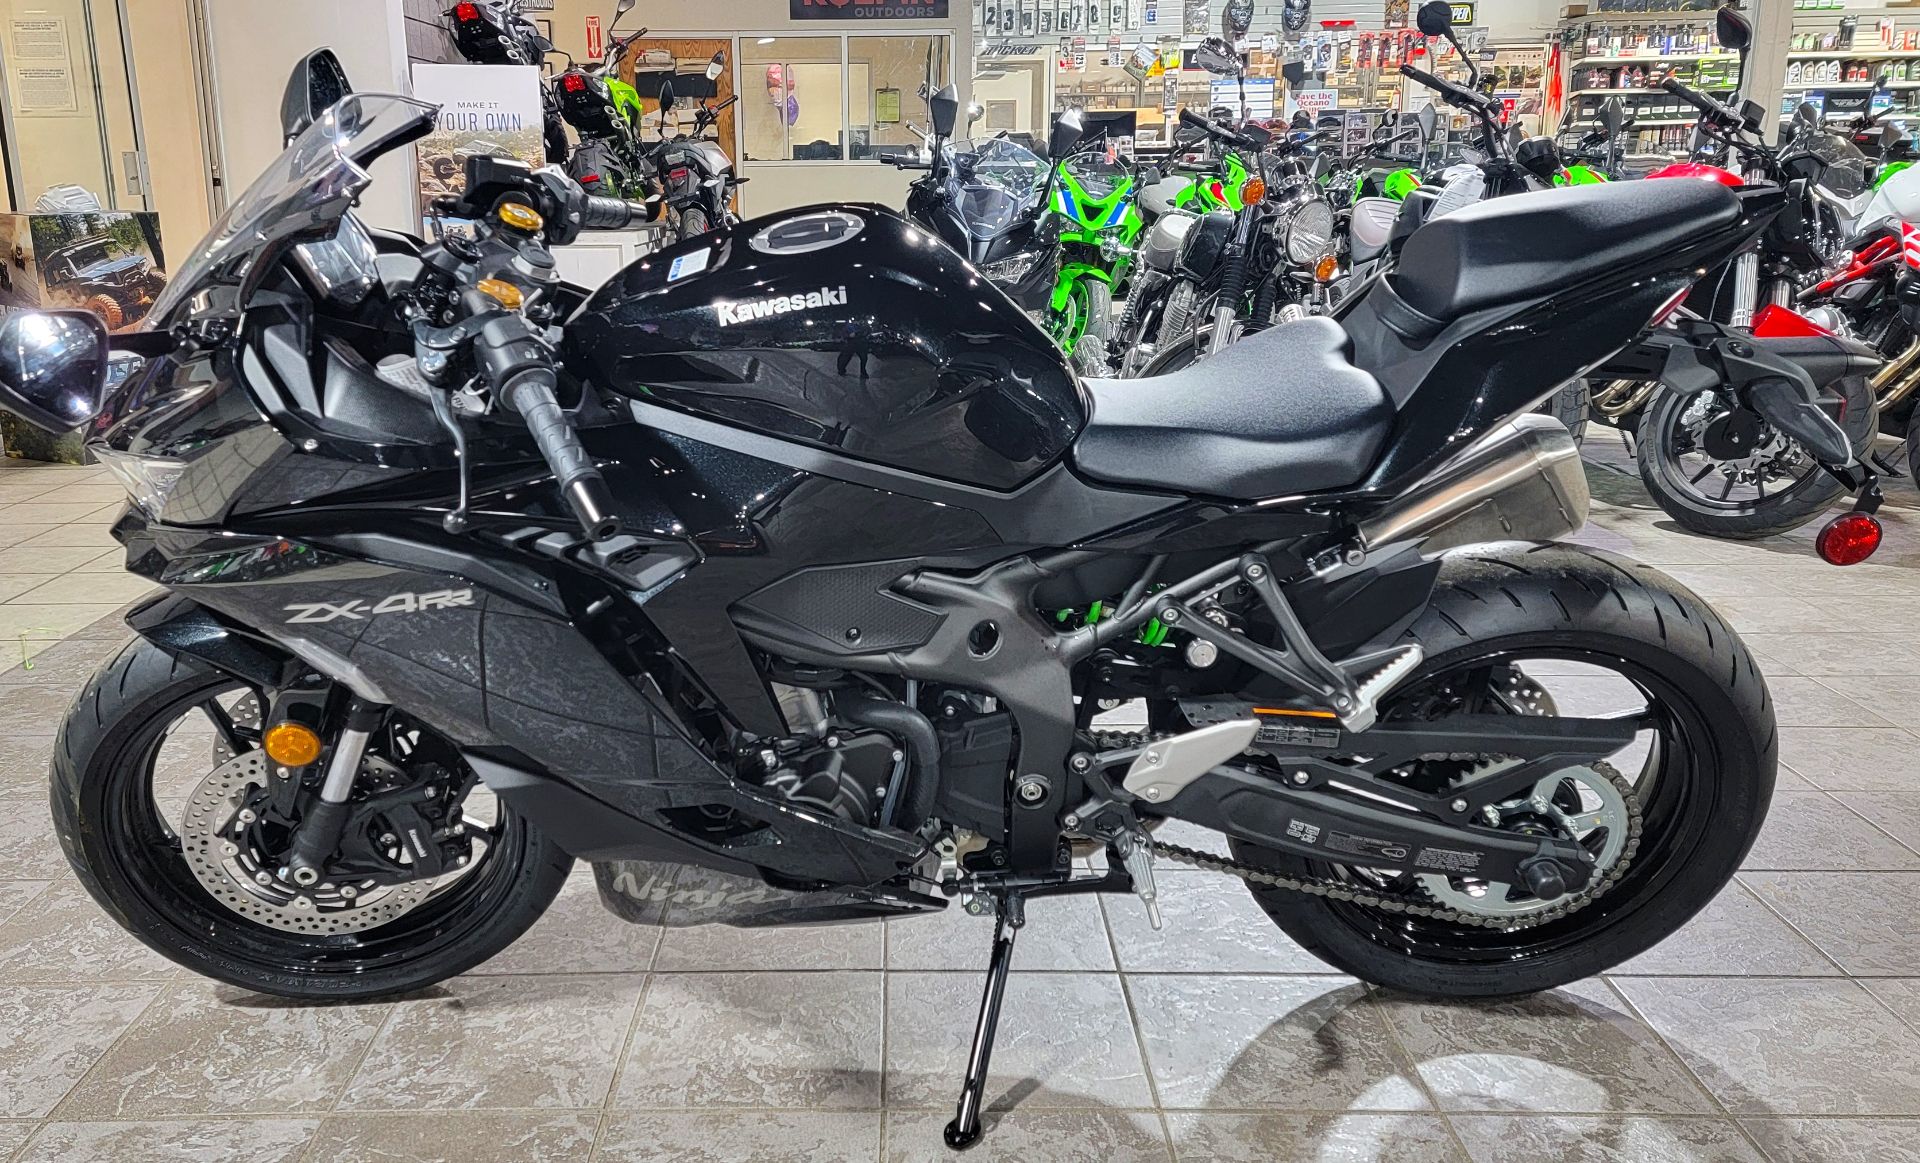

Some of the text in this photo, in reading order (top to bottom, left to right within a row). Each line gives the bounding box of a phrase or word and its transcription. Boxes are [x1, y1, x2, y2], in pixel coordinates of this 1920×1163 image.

[854, 7, 935, 17] OUTDOORS
[986, 7, 996, 25] 2
[1003, 9, 1014, 30] 3
[1297, 99, 1330, 107] Oceano
[1318, 92, 1333, 100] the
[435, 112, 522, 132] YOUR OWN
[717, 285, 847, 327] Kawasaki
[283, 588, 475, 624] ZX-4RR
[612, 871, 787, 911] Ninja
